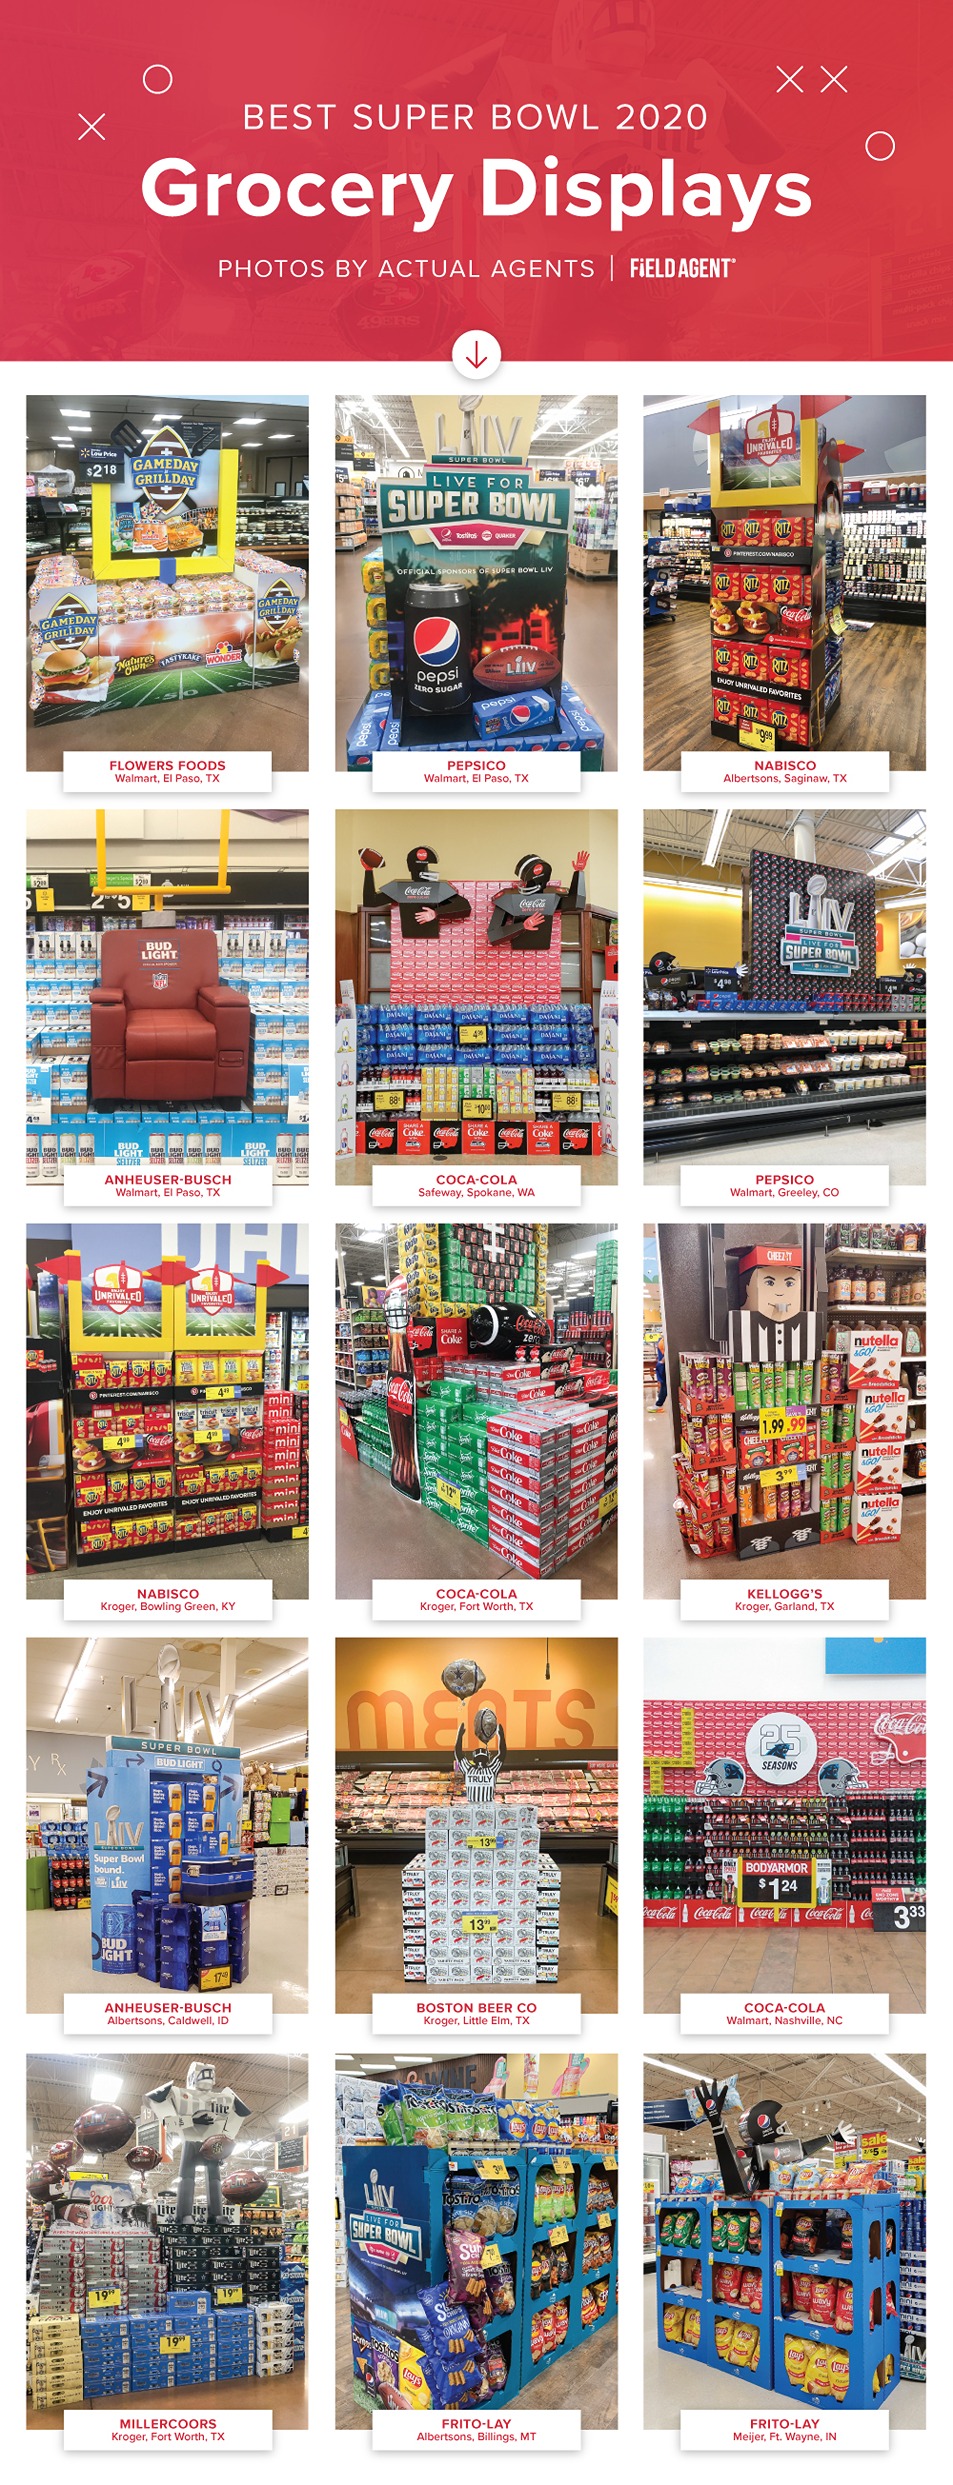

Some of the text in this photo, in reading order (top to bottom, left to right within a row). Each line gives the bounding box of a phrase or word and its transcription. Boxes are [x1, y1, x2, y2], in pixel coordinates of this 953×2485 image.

[746, 436, 793, 455] UNRIVALED
[132, 459, 199, 473] GAMEDAY
[135, 474, 196, 487] GRILLDAY
[433, 476, 523, 489] LIVE FOR
[388, 489, 562, 525] SUPER BOWL
[160, 654, 202, 666] TASTYKAKE
[206, 653, 241, 664] WONDER
[417, 666, 459, 684] pepsi
[414, 682, 463, 693] ZERO SUGAR
[717, 677, 801, 700] ENJOY UNRIVALED FAVORITES
[146, 942, 172, 950] BUD
[141, 951, 178, 960] LIGHT
[786, 946, 854, 964] SUPER BOWL
[403, 1128, 424, 1136] Coke
[441, 1333, 463, 1344] Coke
[854, 1336, 898, 1348] nutella
[275, 1423, 300, 1435] mini
[762, 1420, 784, 1434] 1.99
[104, 1505, 138, 1515] UNRIVALED
[139, 1501, 168, 1509] FAVORITES
[457, 1518, 480, 1533] Sprite
[760, 1724, 801, 1757] 25
[141, 1742, 217, 1755] SUPER BOWL
[157, 1758, 203, 1769] BUD LIGHT
[762, 1761, 797, 1770] SEASONS
[468, 1775, 492, 1783] TRULY
[94, 1854, 145, 1865] Super Bowl
[94, 1864, 124, 1874] bound.
[746, 1862, 808, 1874] BODYARMOR
[694, 1907, 732, 1920] Coca-Cola
[425, 2064, 477, 2092] WINE
[284, 2127, 296, 2137] 21
[862, 2133, 887, 2147] sale
